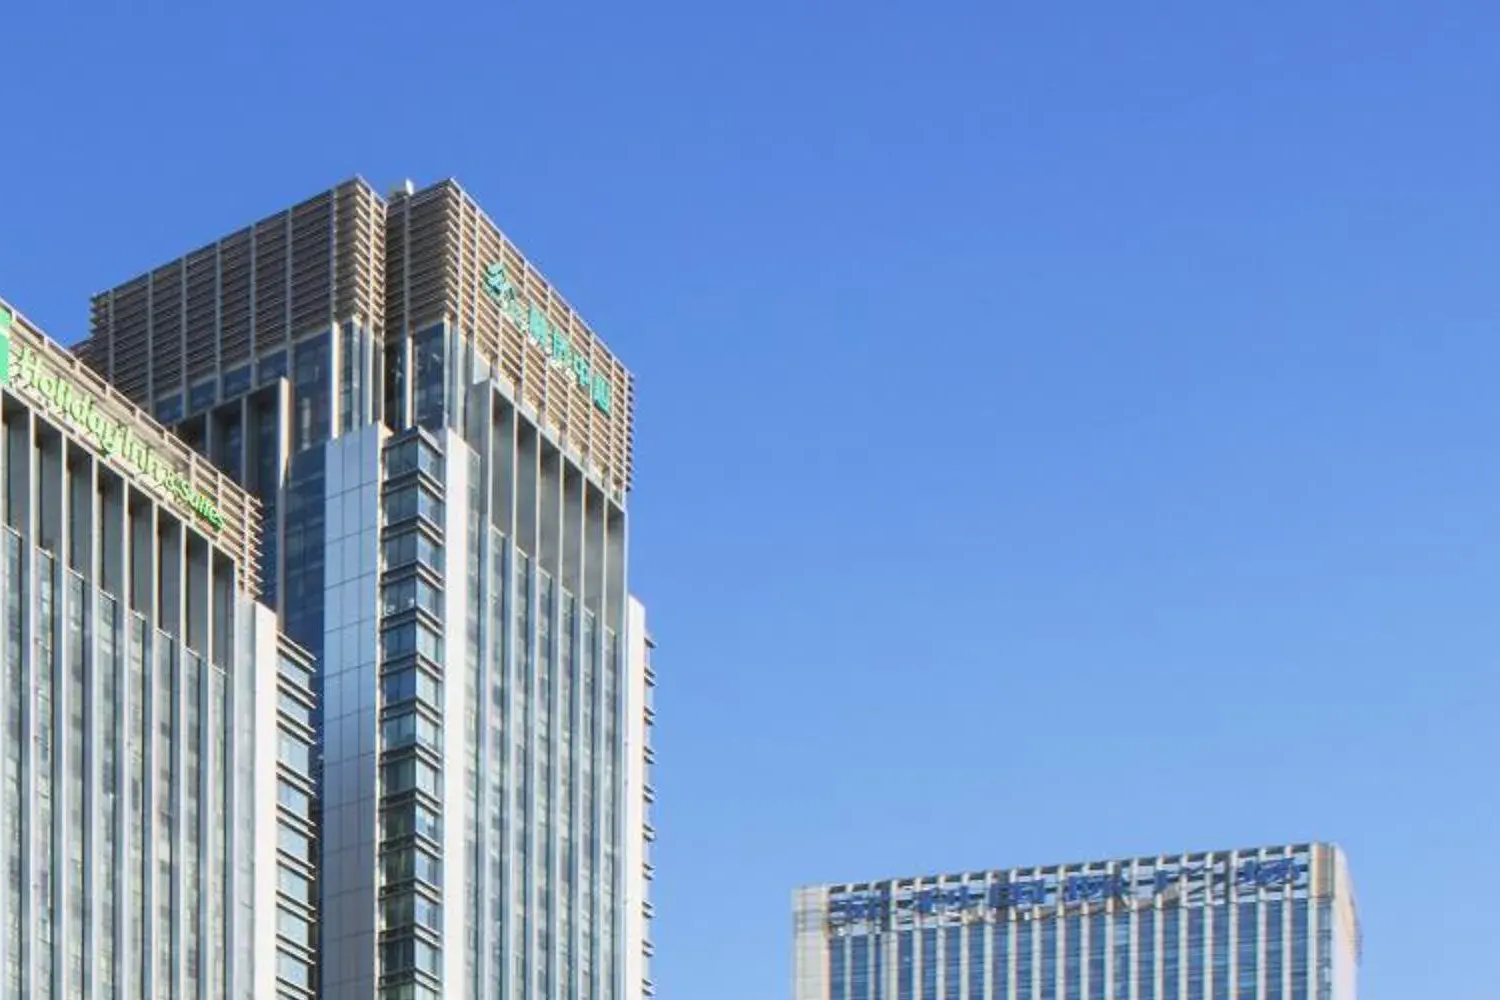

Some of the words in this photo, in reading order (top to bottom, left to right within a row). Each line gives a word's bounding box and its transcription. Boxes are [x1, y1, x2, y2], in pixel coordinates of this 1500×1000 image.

[19, 346, 124, 453] Holiday
[124, 425, 166, 483] Inn
[179, 480, 224, 530] Suites
